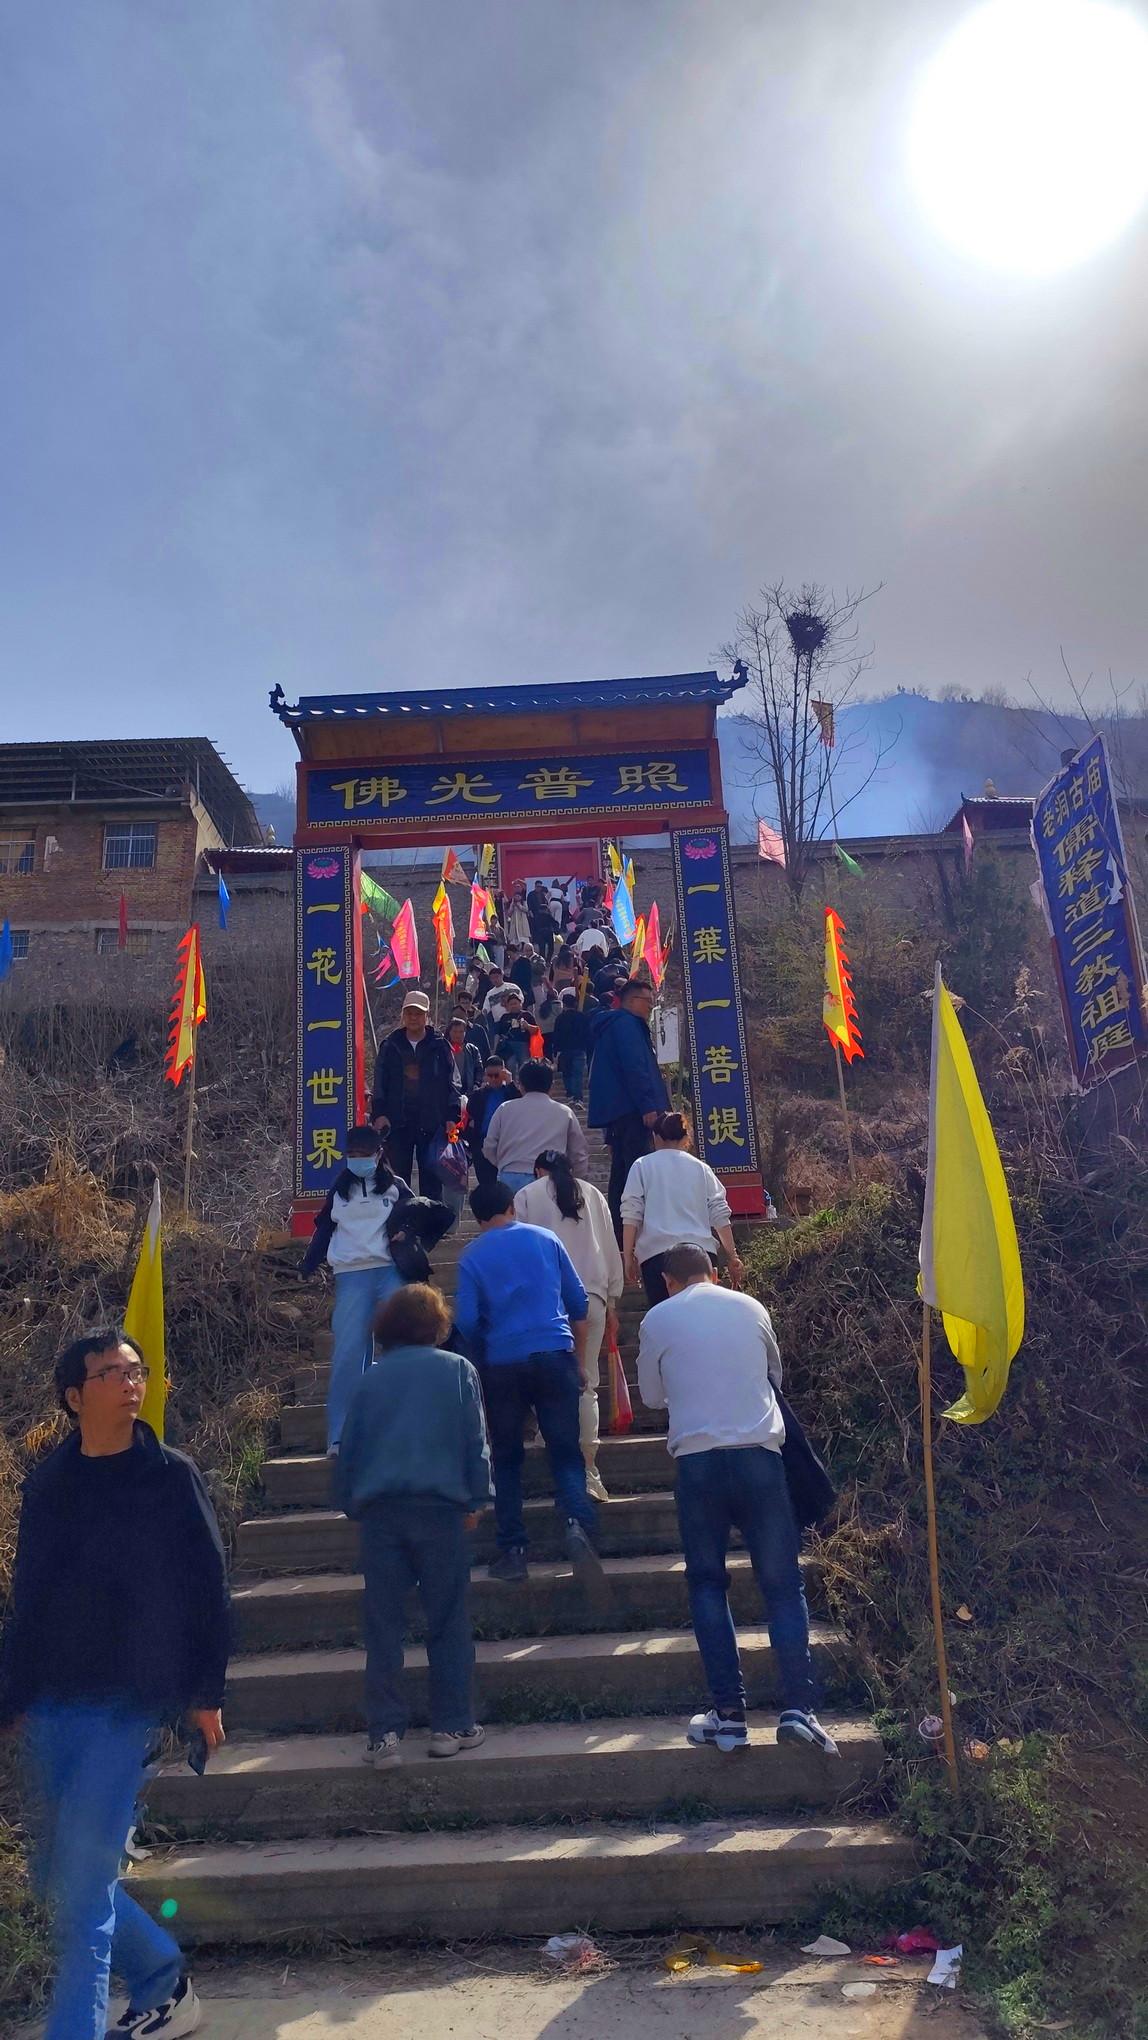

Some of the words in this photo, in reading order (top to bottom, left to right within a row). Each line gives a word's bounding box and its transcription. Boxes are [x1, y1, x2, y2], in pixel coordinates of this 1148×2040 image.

[330, 762, 689, 810] 佛光普照
[306, 903, 344, 1169] 一花一世界
[687, 882, 745, 1147] 一葉一菩提
[1053, 814, 1135, 1065] 儒释道三教祖庭
